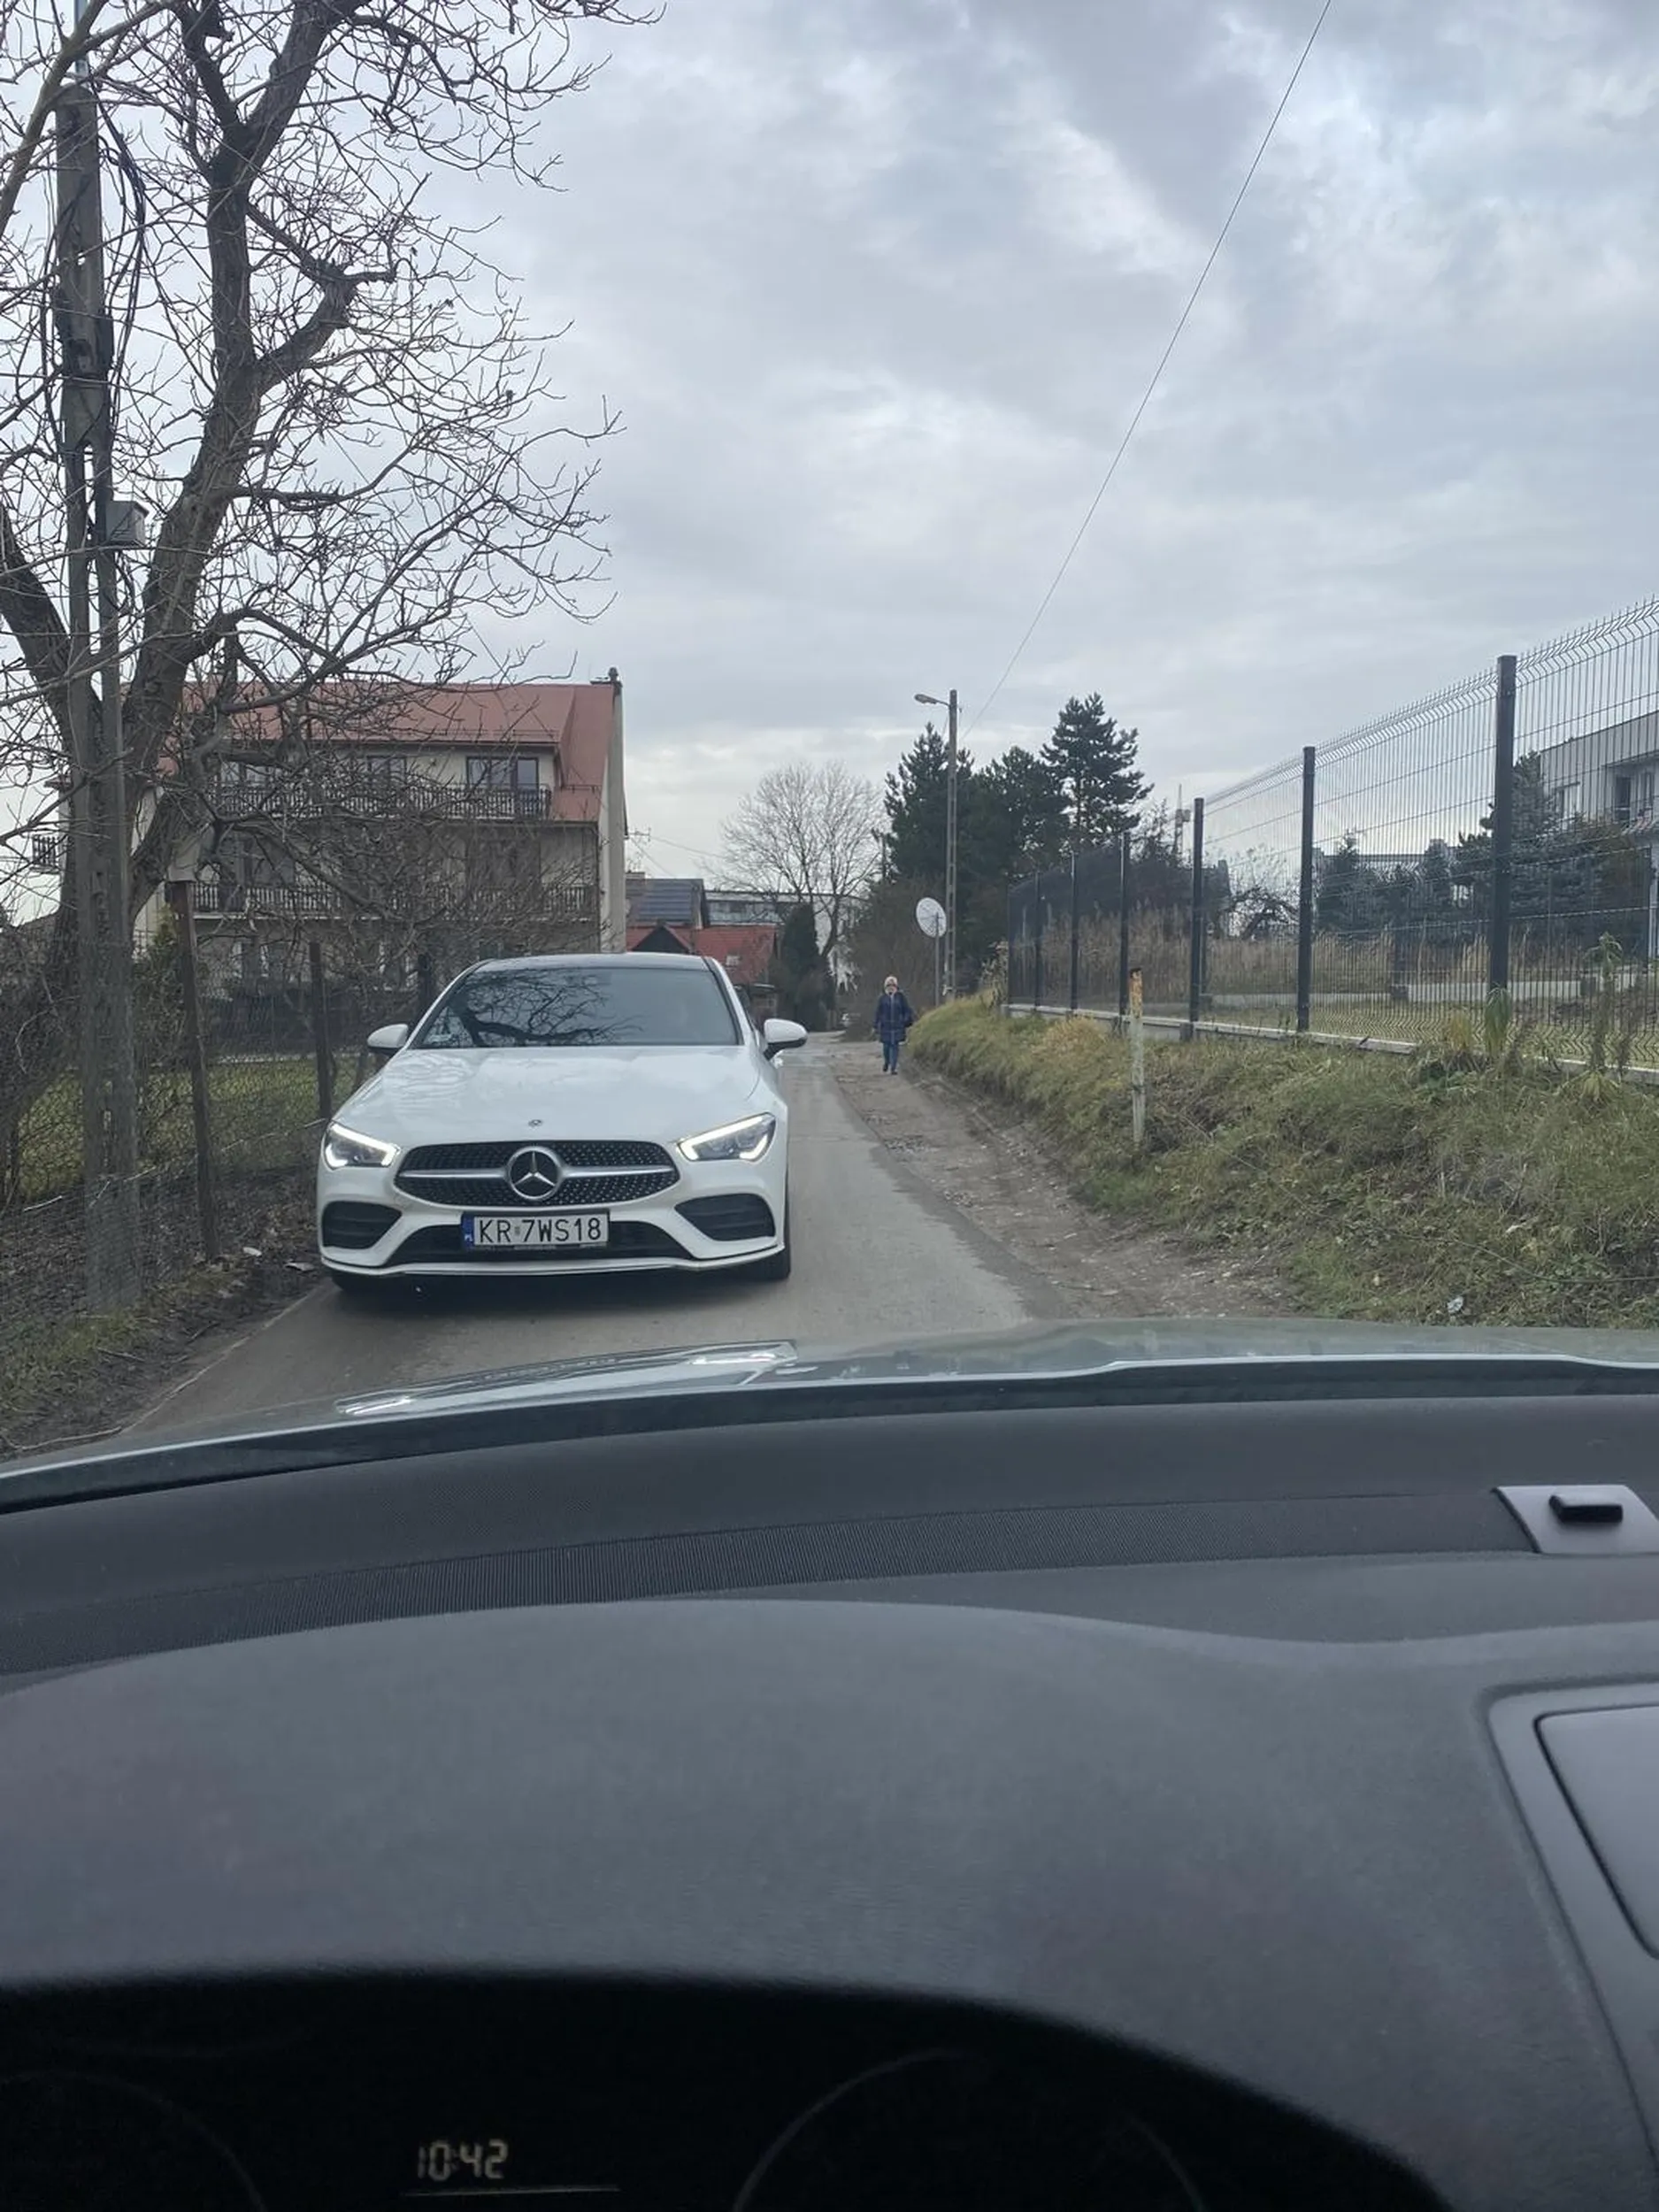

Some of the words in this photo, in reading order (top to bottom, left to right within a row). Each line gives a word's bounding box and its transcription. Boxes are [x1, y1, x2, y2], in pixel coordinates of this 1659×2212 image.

[479, 1219, 511, 1243] KR
[521, 1217, 602, 1242] 7WS18
[418, 2139, 508, 2180] 10:42
